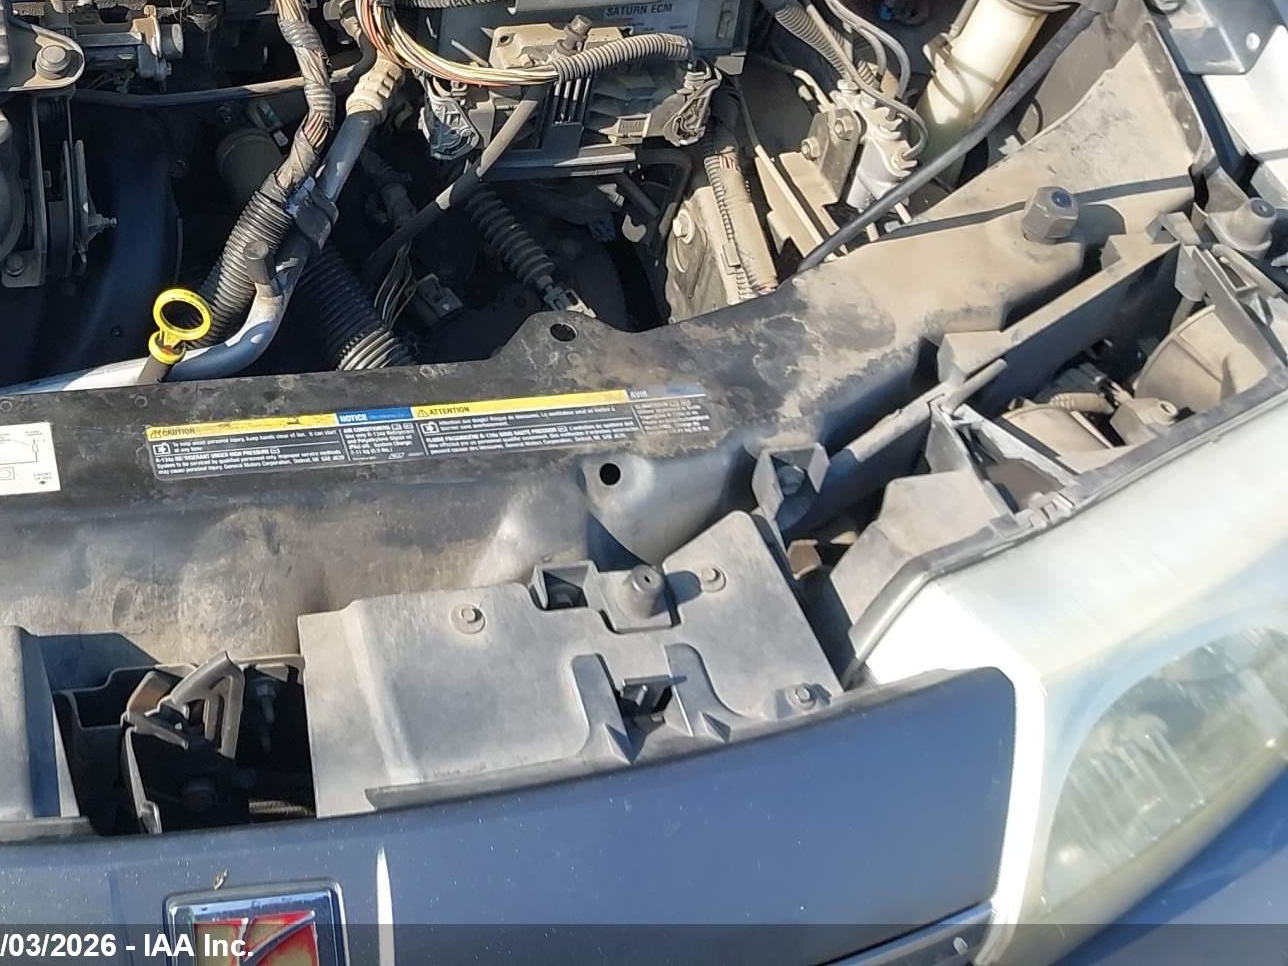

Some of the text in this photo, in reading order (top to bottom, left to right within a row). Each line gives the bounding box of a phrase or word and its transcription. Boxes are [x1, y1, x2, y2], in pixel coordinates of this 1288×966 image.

[606, 3, 673, 16] SATURN ECM
[429, 406, 469, 415] ATTENTION
[339, 413, 367, 422] NOTICE
[162, 427, 194, 436] CAUTION
